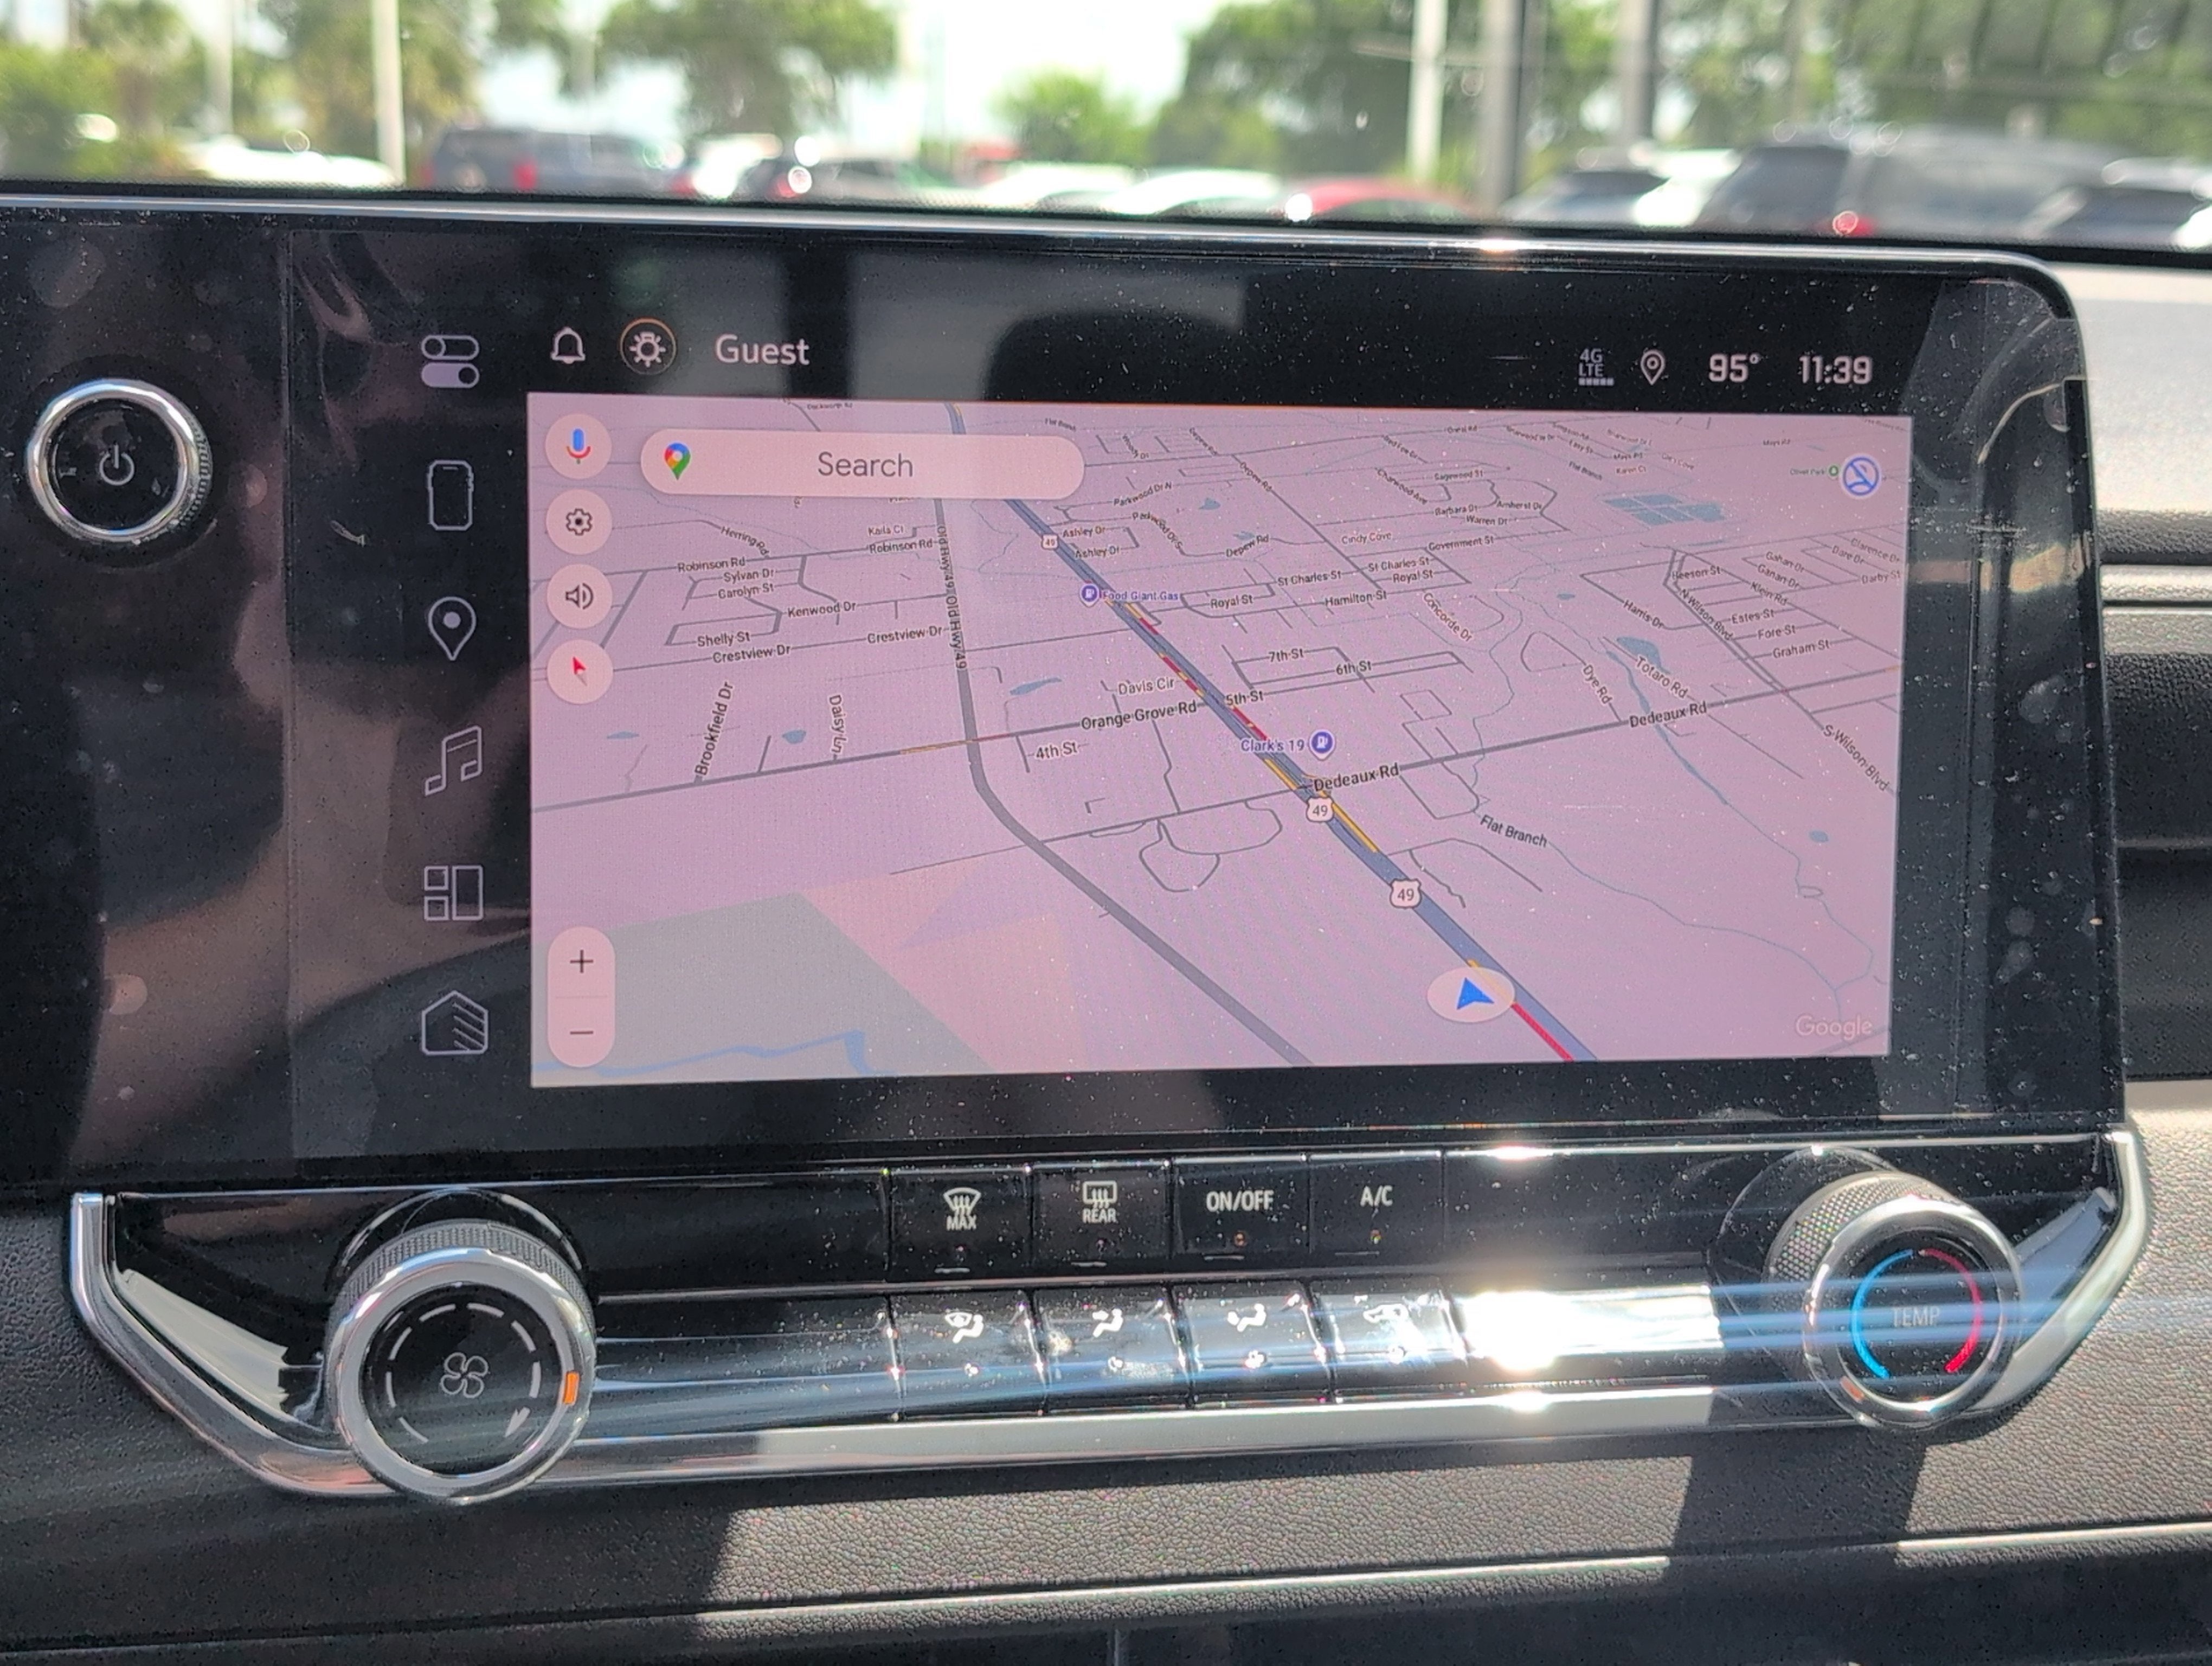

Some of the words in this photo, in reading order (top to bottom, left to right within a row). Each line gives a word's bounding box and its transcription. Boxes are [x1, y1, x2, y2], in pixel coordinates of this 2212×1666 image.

[715, 334, 810, 366] Guest
[1579, 348, 1603, 362] 4G
[1578, 362, 1604, 377] LTE
[1708, 353, 1760, 382] 95°
[1799, 355, 1873, 384] 11:39
[818, 451, 914, 477] Search
[1465, 514, 1496, 526] Warren
[936, 526, 948, 545] Old
[1062, 528, 1094, 538] Ashley
[1341, 534, 1368, 544] Cindy
[869, 542, 917, 554] Robinson
[918, 538, 933, 549] Rd
[1428, 537, 1482, 552] Government
[1484, 535, 1495, 544] St
[677, 559, 729, 573] Robinson
[731, 556, 747, 567] Rd
[938, 545, 950, 573] Hwy
[1368, 562, 1380, 572] St
[1381, 559, 1417, 571] Charles
[1418, 556, 1430, 566] St
[723, 570, 759, 584] Sylvan
[762, 568, 775, 578] Dr
[1277, 576, 1290, 586] St
[1291, 572, 1328, 585] Charles
[1329, 570, 1342, 580] St
[1392, 572, 1421, 584] Royal
[1422, 569, 1434, 579] St
[718, 585, 760, 599] Carolyn
[762, 582, 775, 592] St
[1102, 591, 1128, 600] Food
[1159, 591, 1179, 601] Gas
[1324, 592, 1373, 607] Hamilton
[1374, 589, 1387, 601] St
[1773, 593, 1789, 606] Rd
[787, 605, 841, 618] Kenwood
[843, 601, 857, 612] Dr
[945, 595, 960, 618] Old
[1210, 596, 1239, 610] Royal
[1240, 594, 1253, 604] St
[1423, 592, 1463, 632] Concorde
[1458, 625, 1473, 643] Dr
[1623, 599, 1653, 624] Harris
[1650, 617, 1664, 630] Dr
[1686, 595, 1715, 624] Wilson
[1713, 619, 1734, 641] Blvd
[1762, 608, 1775, 619] St
[867, 627, 926, 645] Crestview
[928, 625, 943, 638] Dr
[949, 620, 962, 650] Hwy
[1783, 625, 1797, 635] St
[697, 633, 734, 648] Shelly
[736, 631, 751, 643] St
[712, 646, 774, 663] Crestview
[776, 644, 792, 656] Dr
[1268, 650, 1288, 663] 7th
[1289, 648, 1305, 660] St
[1772, 644, 1817, 659] Graham
[1817, 639, 1830, 649] St
[955, 651, 968, 670] 49
[1335, 662, 1355, 675] 6th
[1356, 659, 1373, 672] St
[1117, 681, 1154, 696] Davis
[1156, 677, 1175, 691] Cir
[1582, 664, 1603, 693] Dye
[1596, 685, 1613, 706] Rd
[1635, 656, 1669, 688] Totaro
[1667, 680, 1688, 700] Rd
[1226, 692, 1246, 706] 5th
[1249, 689, 1264, 703] St
[828, 694, 847, 733] Daisy
[1081, 710, 1131, 731] Orange
[1134, 706, 1174, 722] Grove
[1178, 700, 1198, 714] Rd
[1629, 707, 1687, 729] Dedeaux
[1688, 701, 1708, 716] Rd
[694, 701, 729, 777] Brookfield
[717, 681, 735, 702] Dr
[832, 735, 847, 754] Ln
[1036, 744, 1059, 759] 4th
[1059, 741, 1078, 755] St
[1240, 738, 1284, 753] Clark's
[1288, 738, 1304, 752] 19
[1822, 724, 1835, 738] S
[1832, 729, 1866, 769] Wilson
[1864, 764, 1890, 792] Blvd
[1313, 768, 1377, 792] Dedeaux
[1378, 762, 1400, 779] Rd
[1312, 805, 1328, 817] 49
[1480, 813, 1504, 835] Flat
[1503, 825, 1548, 848] Branch
[1397, 888, 1415, 902] 49
[1796, 1015, 1873, 1040] Google
[1206, 1189, 1274, 1212] ON/OFF
[1360, 1186, 1393, 1207] A/C
[946, 1215, 978, 1231] MAX
[1083, 1208, 1118, 1223] REAR
[1891, 1305, 1940, 1327] TEMP
